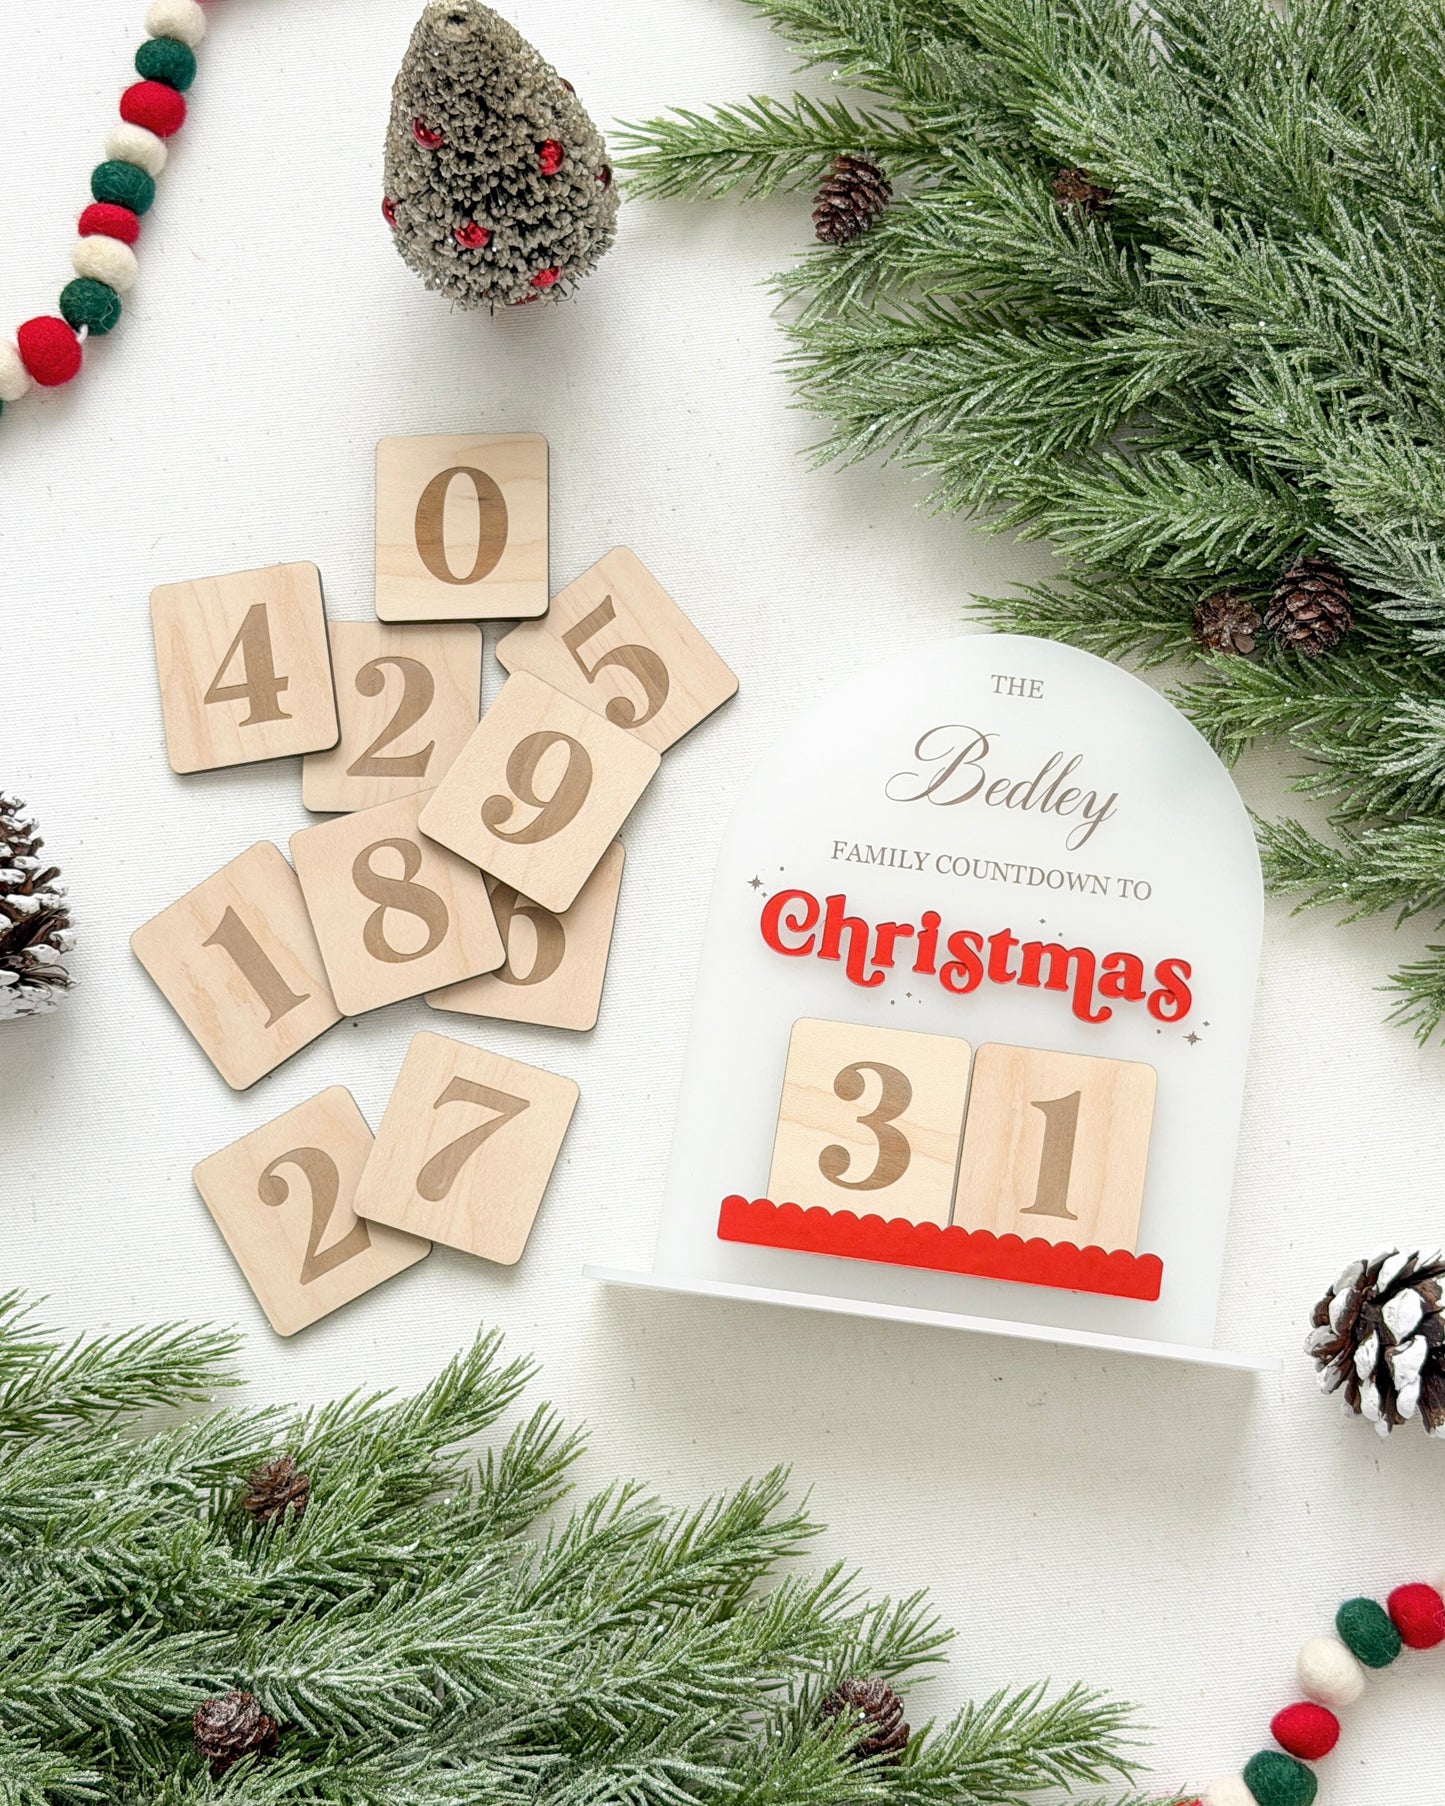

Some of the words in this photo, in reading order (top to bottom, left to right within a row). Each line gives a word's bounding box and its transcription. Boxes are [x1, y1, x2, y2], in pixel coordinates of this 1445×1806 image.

[203, 602, 293, 727] 4
[346, 655, 436, 778] 2
[560, 594, 670, 730] 5
[991, 674, 1044, 700] THE
[480, 730, 593, 845] 9
[885, 724, 1118, 851] Bedley
[351, 837, 449, 964] 8
[830, 840, 930, 874] FAMILY
[935, 854, 1112, 896] COUNTDOWN
[1117, 877, 1152, 901] TO
[201, 905, 311, 1029] 1
[760, 888, 1193, 1024] Christmas
[416, 1076, 530, 1202] 7
[257, 1146, 372, 1286] 2
